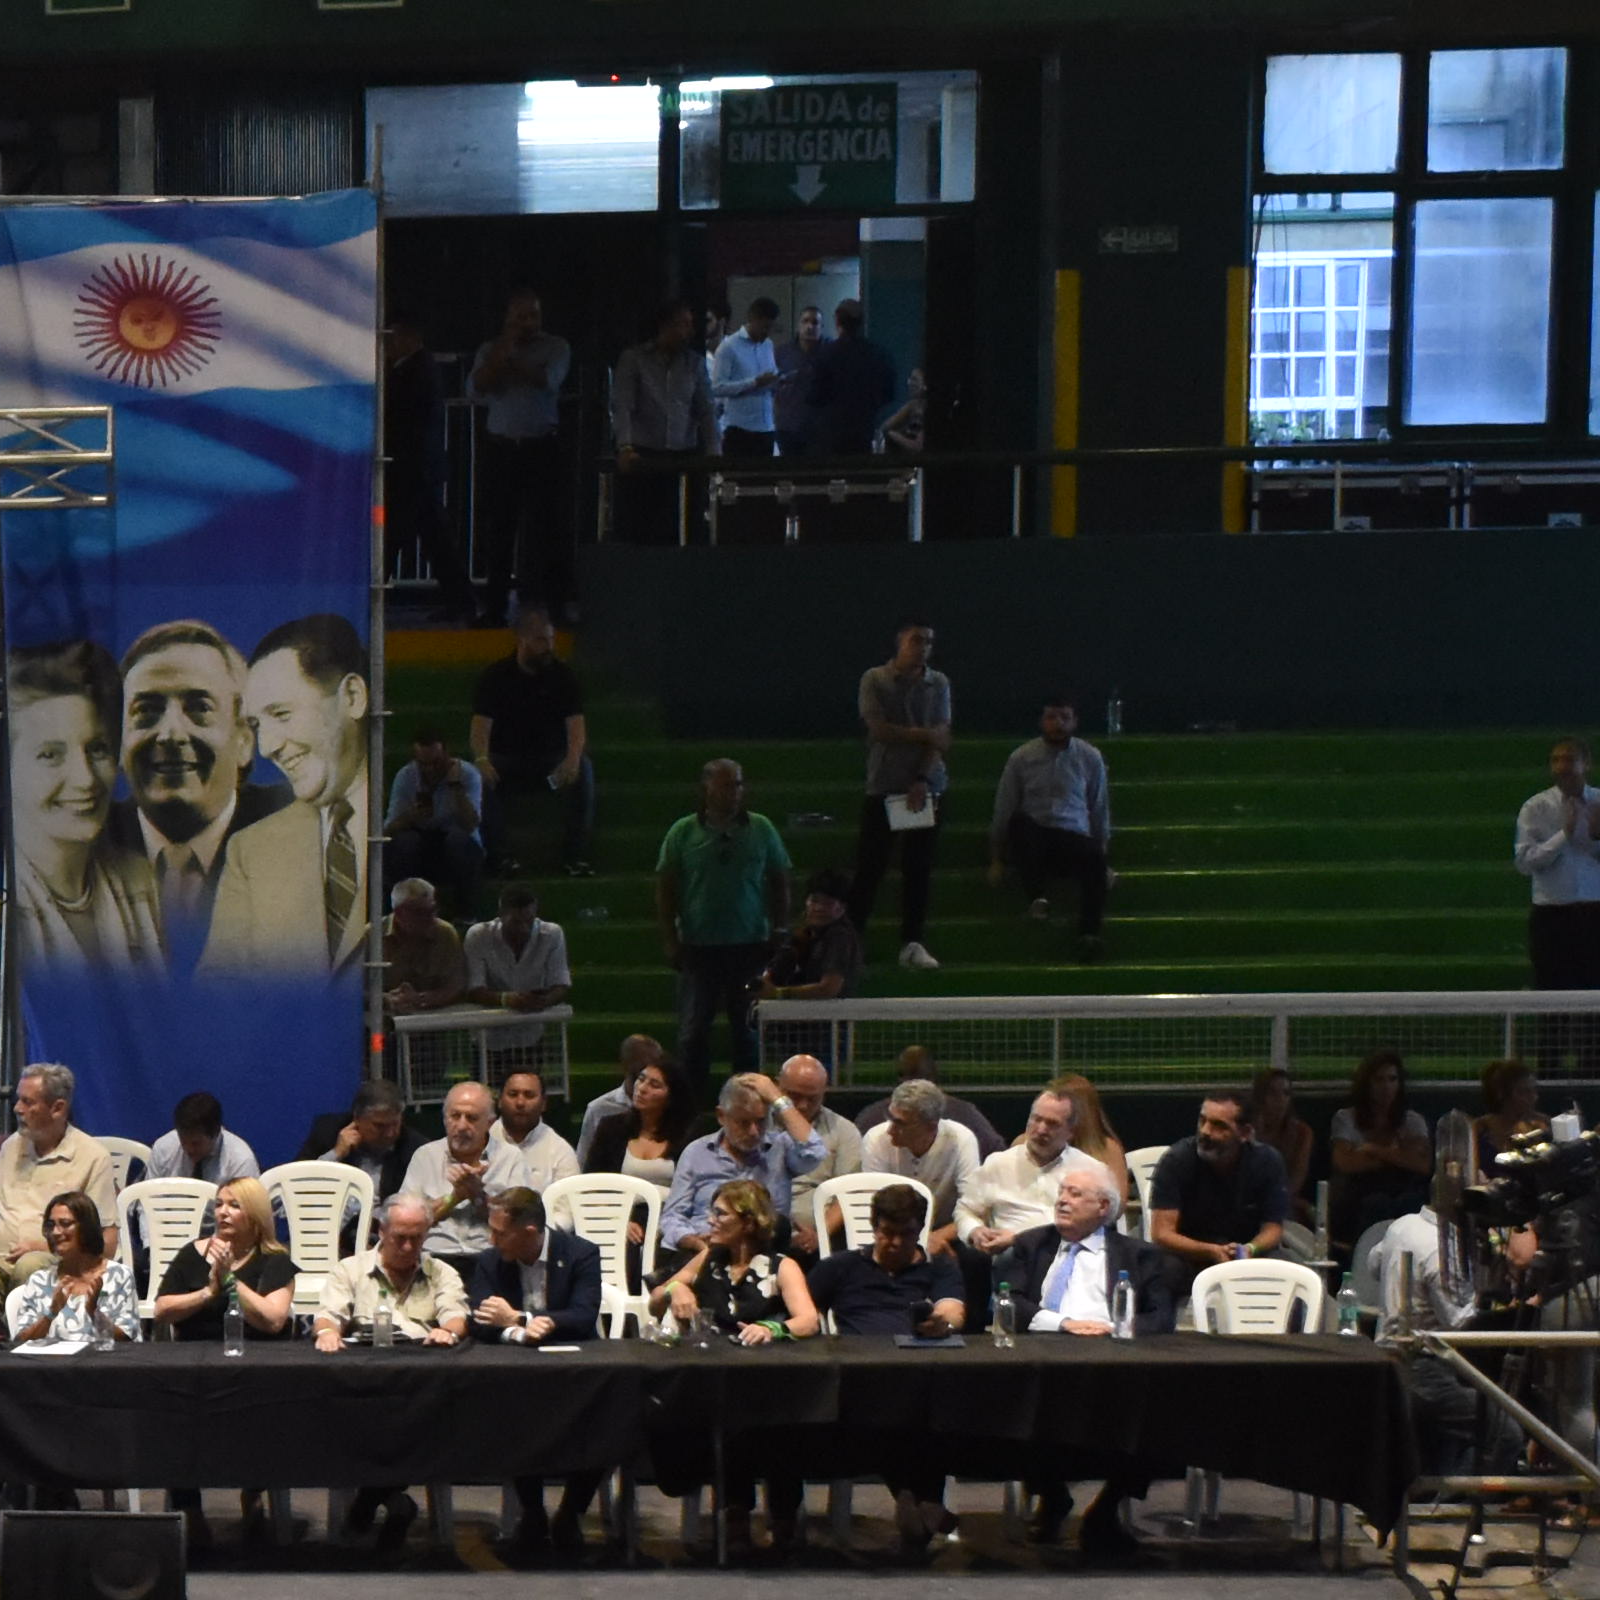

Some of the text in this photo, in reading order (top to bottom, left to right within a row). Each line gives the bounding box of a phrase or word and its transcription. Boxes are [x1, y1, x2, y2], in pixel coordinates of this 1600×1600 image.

[731, 91, 890, 124] SALIDA de
[726, 127, 894, 163] EMERGENCIA
